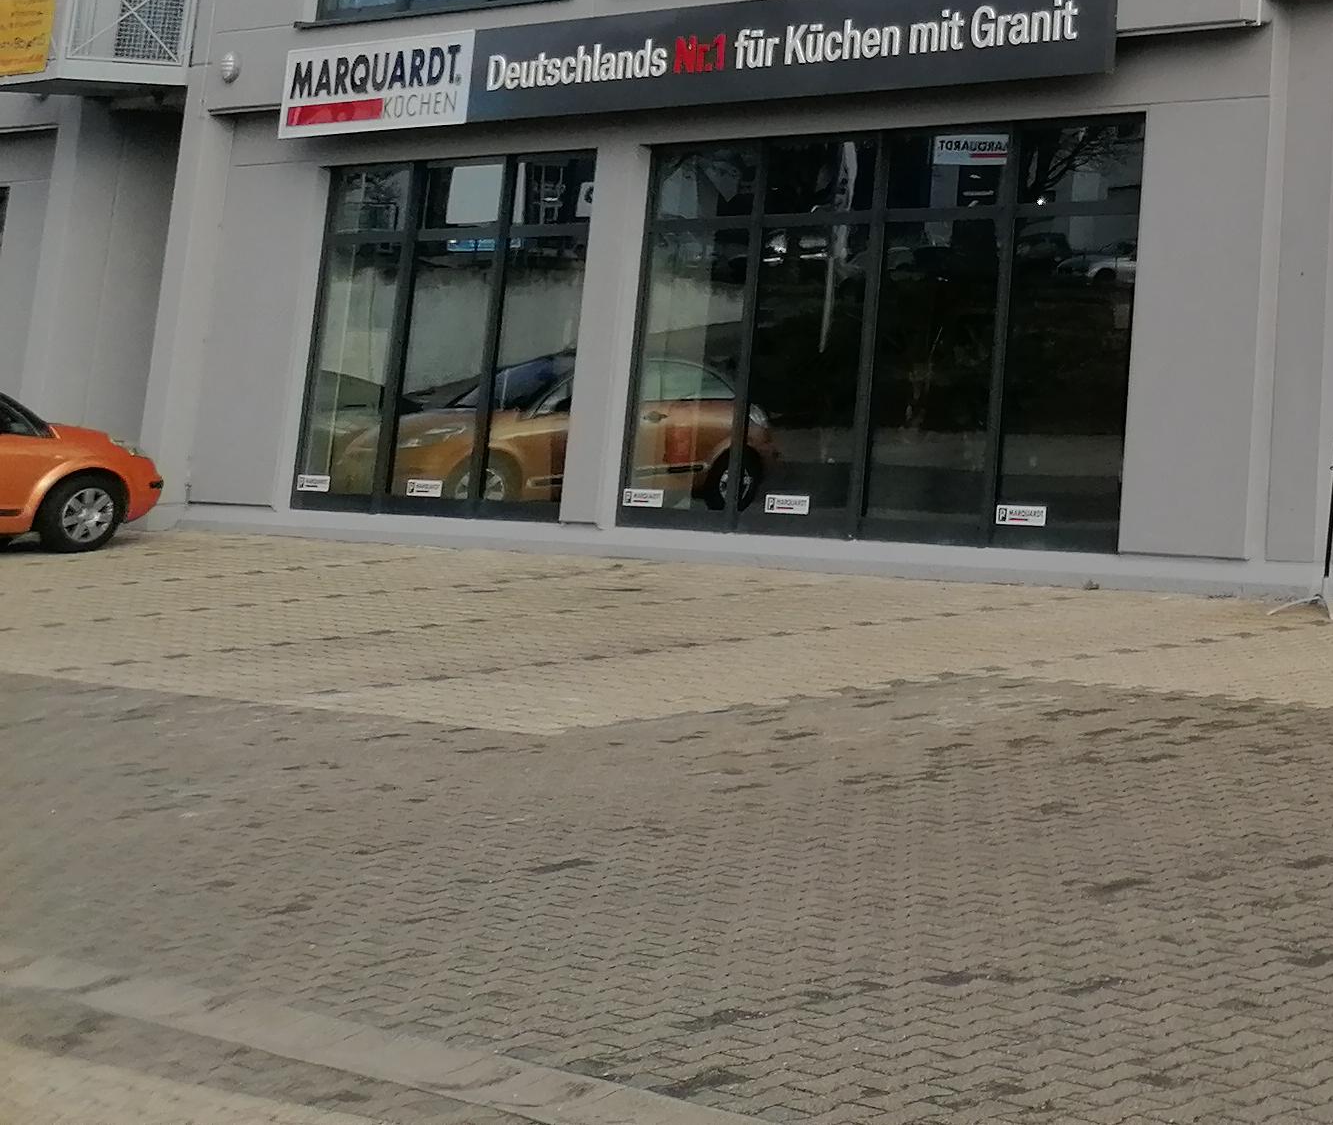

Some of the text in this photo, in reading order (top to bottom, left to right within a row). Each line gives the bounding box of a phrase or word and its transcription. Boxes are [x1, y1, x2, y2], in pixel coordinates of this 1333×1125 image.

[289, 44, 462, 100] MARQUARDT
[485, 38, 668, 92] Deutschlands
[672, 34, 728, 74] Nr.1
[734, 28, 780, 70] für
[783, 19, 900, 66] Küchen
[908, 8, 965, 55] mit
[382, 91, 458, 120] KÜCHEN
